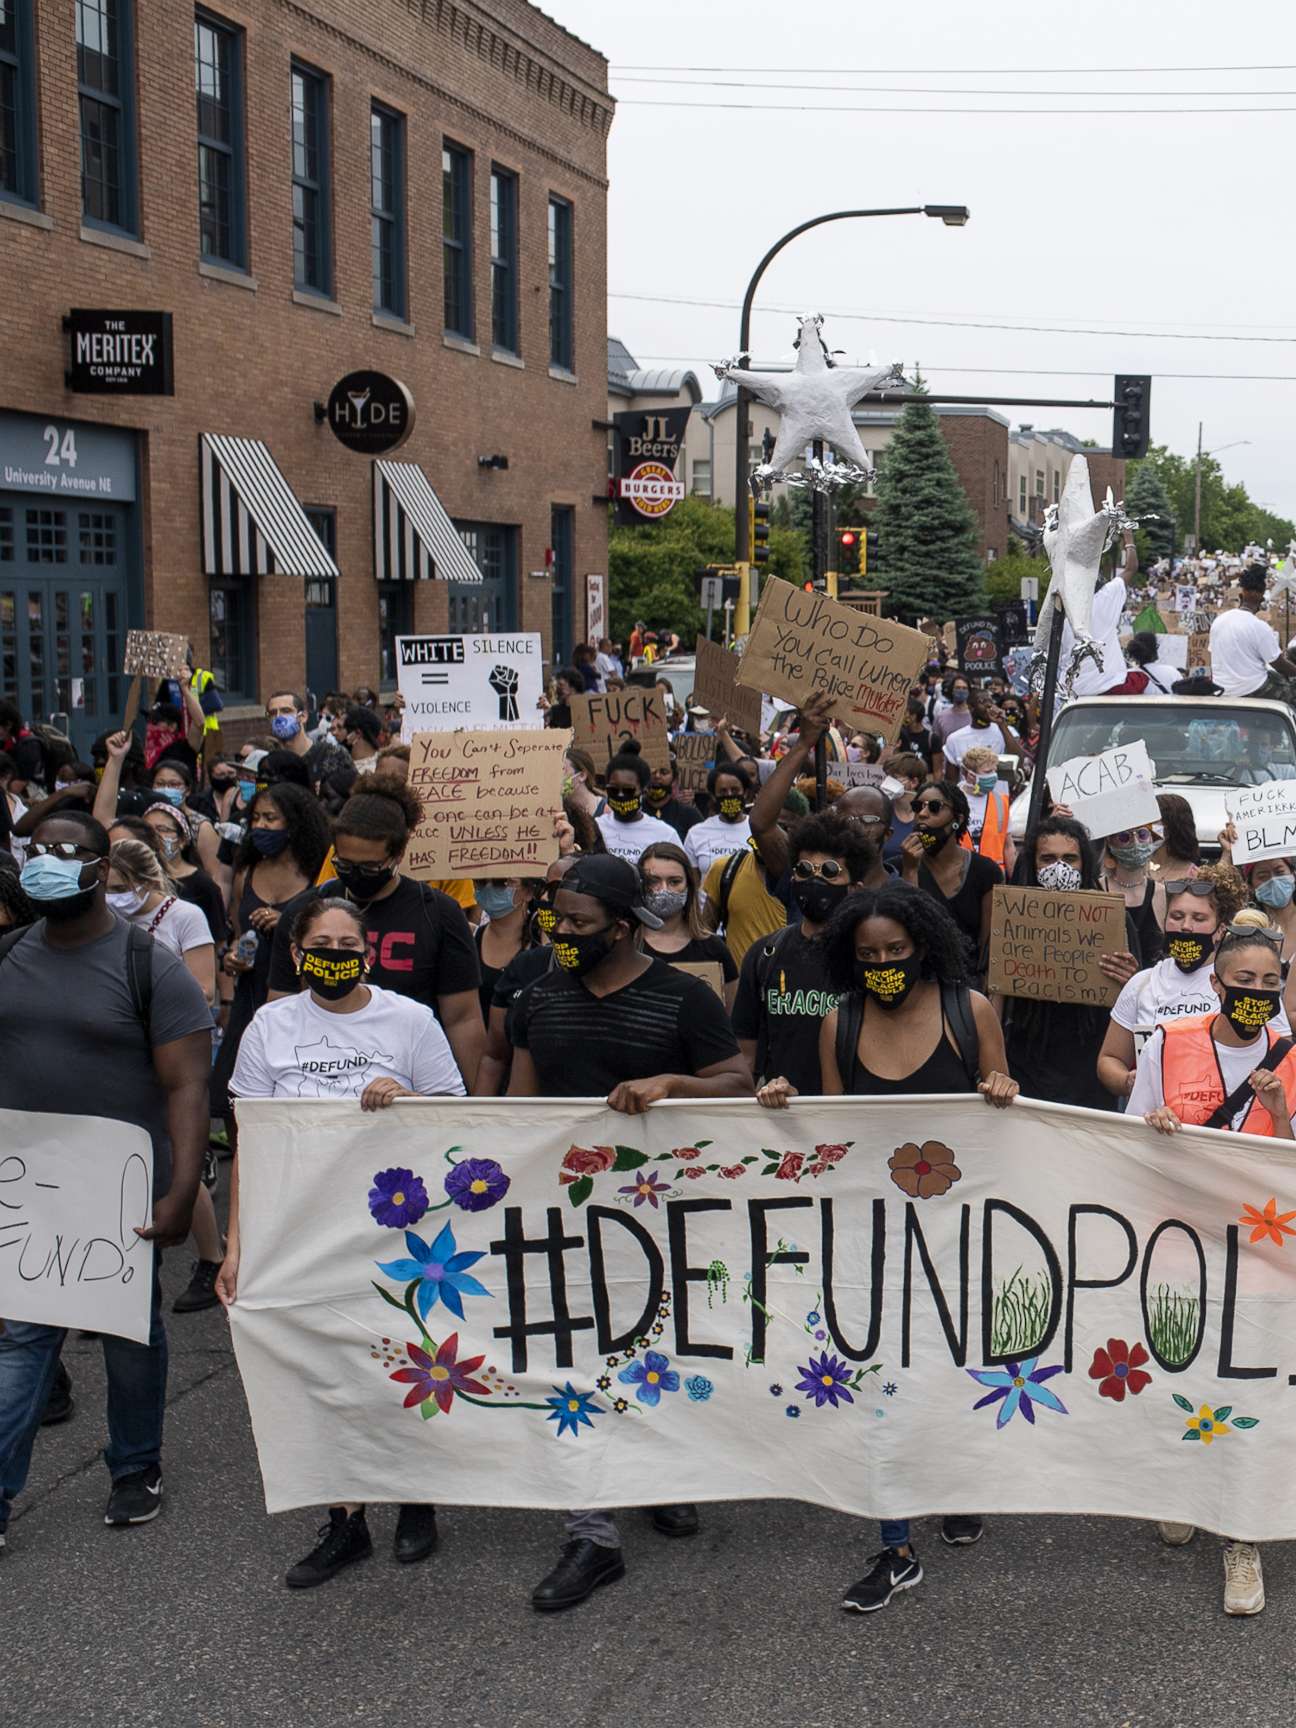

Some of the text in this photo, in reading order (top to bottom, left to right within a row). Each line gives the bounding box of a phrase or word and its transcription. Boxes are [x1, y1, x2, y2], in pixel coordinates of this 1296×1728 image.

[105, 321, 125, 331] THE
[77, 332, 153, 365] MERITEX
[90, 366, 141, 376] COMPANY
[43, 425, 77, 468] 24
[629, 436, 678, 458] Beers
[5, 466, 112, 492] University Avenue NE
[639, 465, 667, 477] GREAT
[624, 482, 681, 496] BURGERS
[784, 589, 894, 654] Who Do
[402, 640, 533, 662] WHITE SILENCE
[775, 625, 815, 665] You
[858, 659, 913, 694] When
[965, 661, 997, 671] POOLICE
[770, 653, 803, 682] the
[812, 668, 855, 700] Police
[411, 700, 471, 715] VIOLENCE
[588, 696, 662, 725] FUCK
[420, 739, 451, 763] You
[462, 739, 502, 759] Can't
[411, 764, 524, 783] FREEDOM from
[1060, 753, 1133, 802] ACAB
[476, 785, 539, 799] because
[1239, 788, 1286, 804] FUCK
[434, 810, 465, 823] one
[474, 809, 503, 821] can
[509, 805, 529, 820] be
[535, 806, 554, 817] at
[450, 825, 508, 841] UNLESS
[517, 825, 541, 839] HE
[410, 843, 538, 866] HAS FREEDOM!!
[1003, 894, 1114, 922] We are NOT
[1003, 919, 1105, 948] Animals We
[306, 953, 360, 968] DEFUND
[1002, 941, 1096, 967] are People
[302, 963, 360, 981] POLICE
[864, 970, 906, 983] KILLING
[873, 967, 896, 977] STOP
[1004, 959, 1056, 979] Death
[865, 978, 905, 990] BLACK
[1157, 1002, 1211, 1016] #DEFUND
[1234, 999, 1273, 1014] KILLING
[1243, 997, 1271, 1007] STOP
[1235, 1008, 1269, 1020] BLACK
[302, 1056, 368, 1073] #DEFUND
